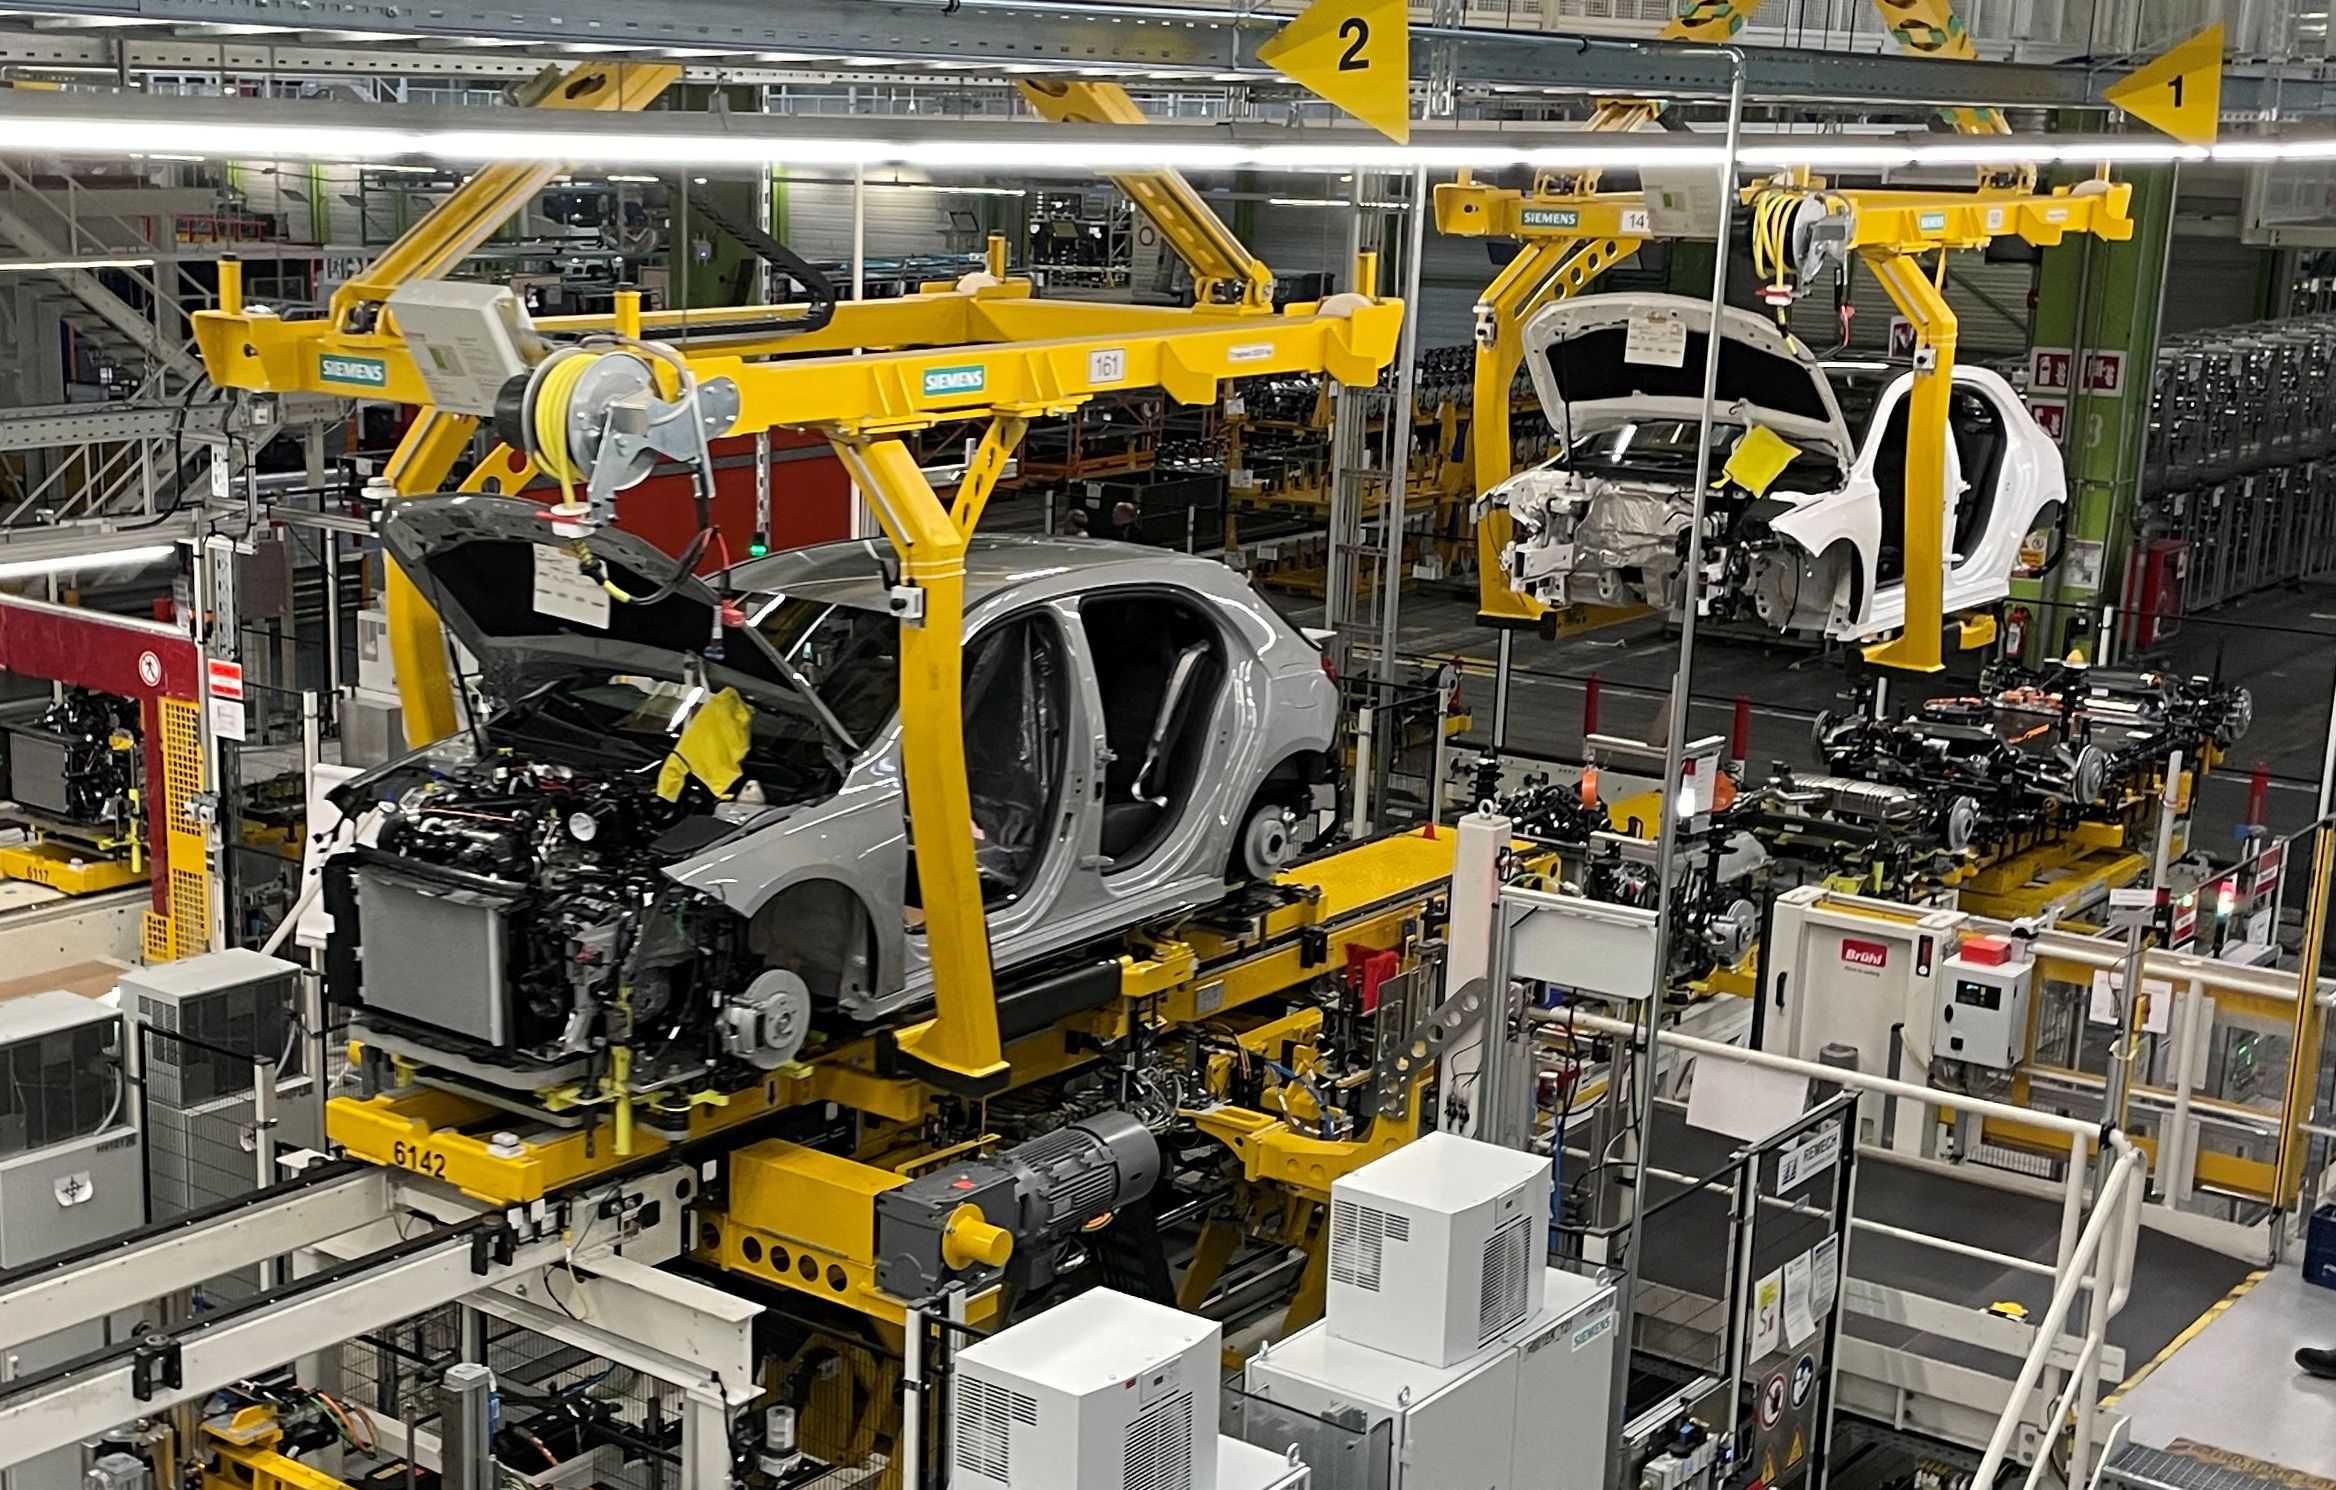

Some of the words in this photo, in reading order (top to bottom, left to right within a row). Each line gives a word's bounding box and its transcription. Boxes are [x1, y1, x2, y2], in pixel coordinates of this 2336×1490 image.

[1339, 17, 1369, 71] 2
[2167, 75, 2183, 108] 1
[1523, 211, 1576, 226] SIEMENS
[322, 360, 384, 381] SIEMENS
[1096, 355, 1117, 377] 161
[925, 369, 983, 391] SIEMENS
[26, 865, 49, 882] 6117
[394, 1140, 447, 1181] 6142
